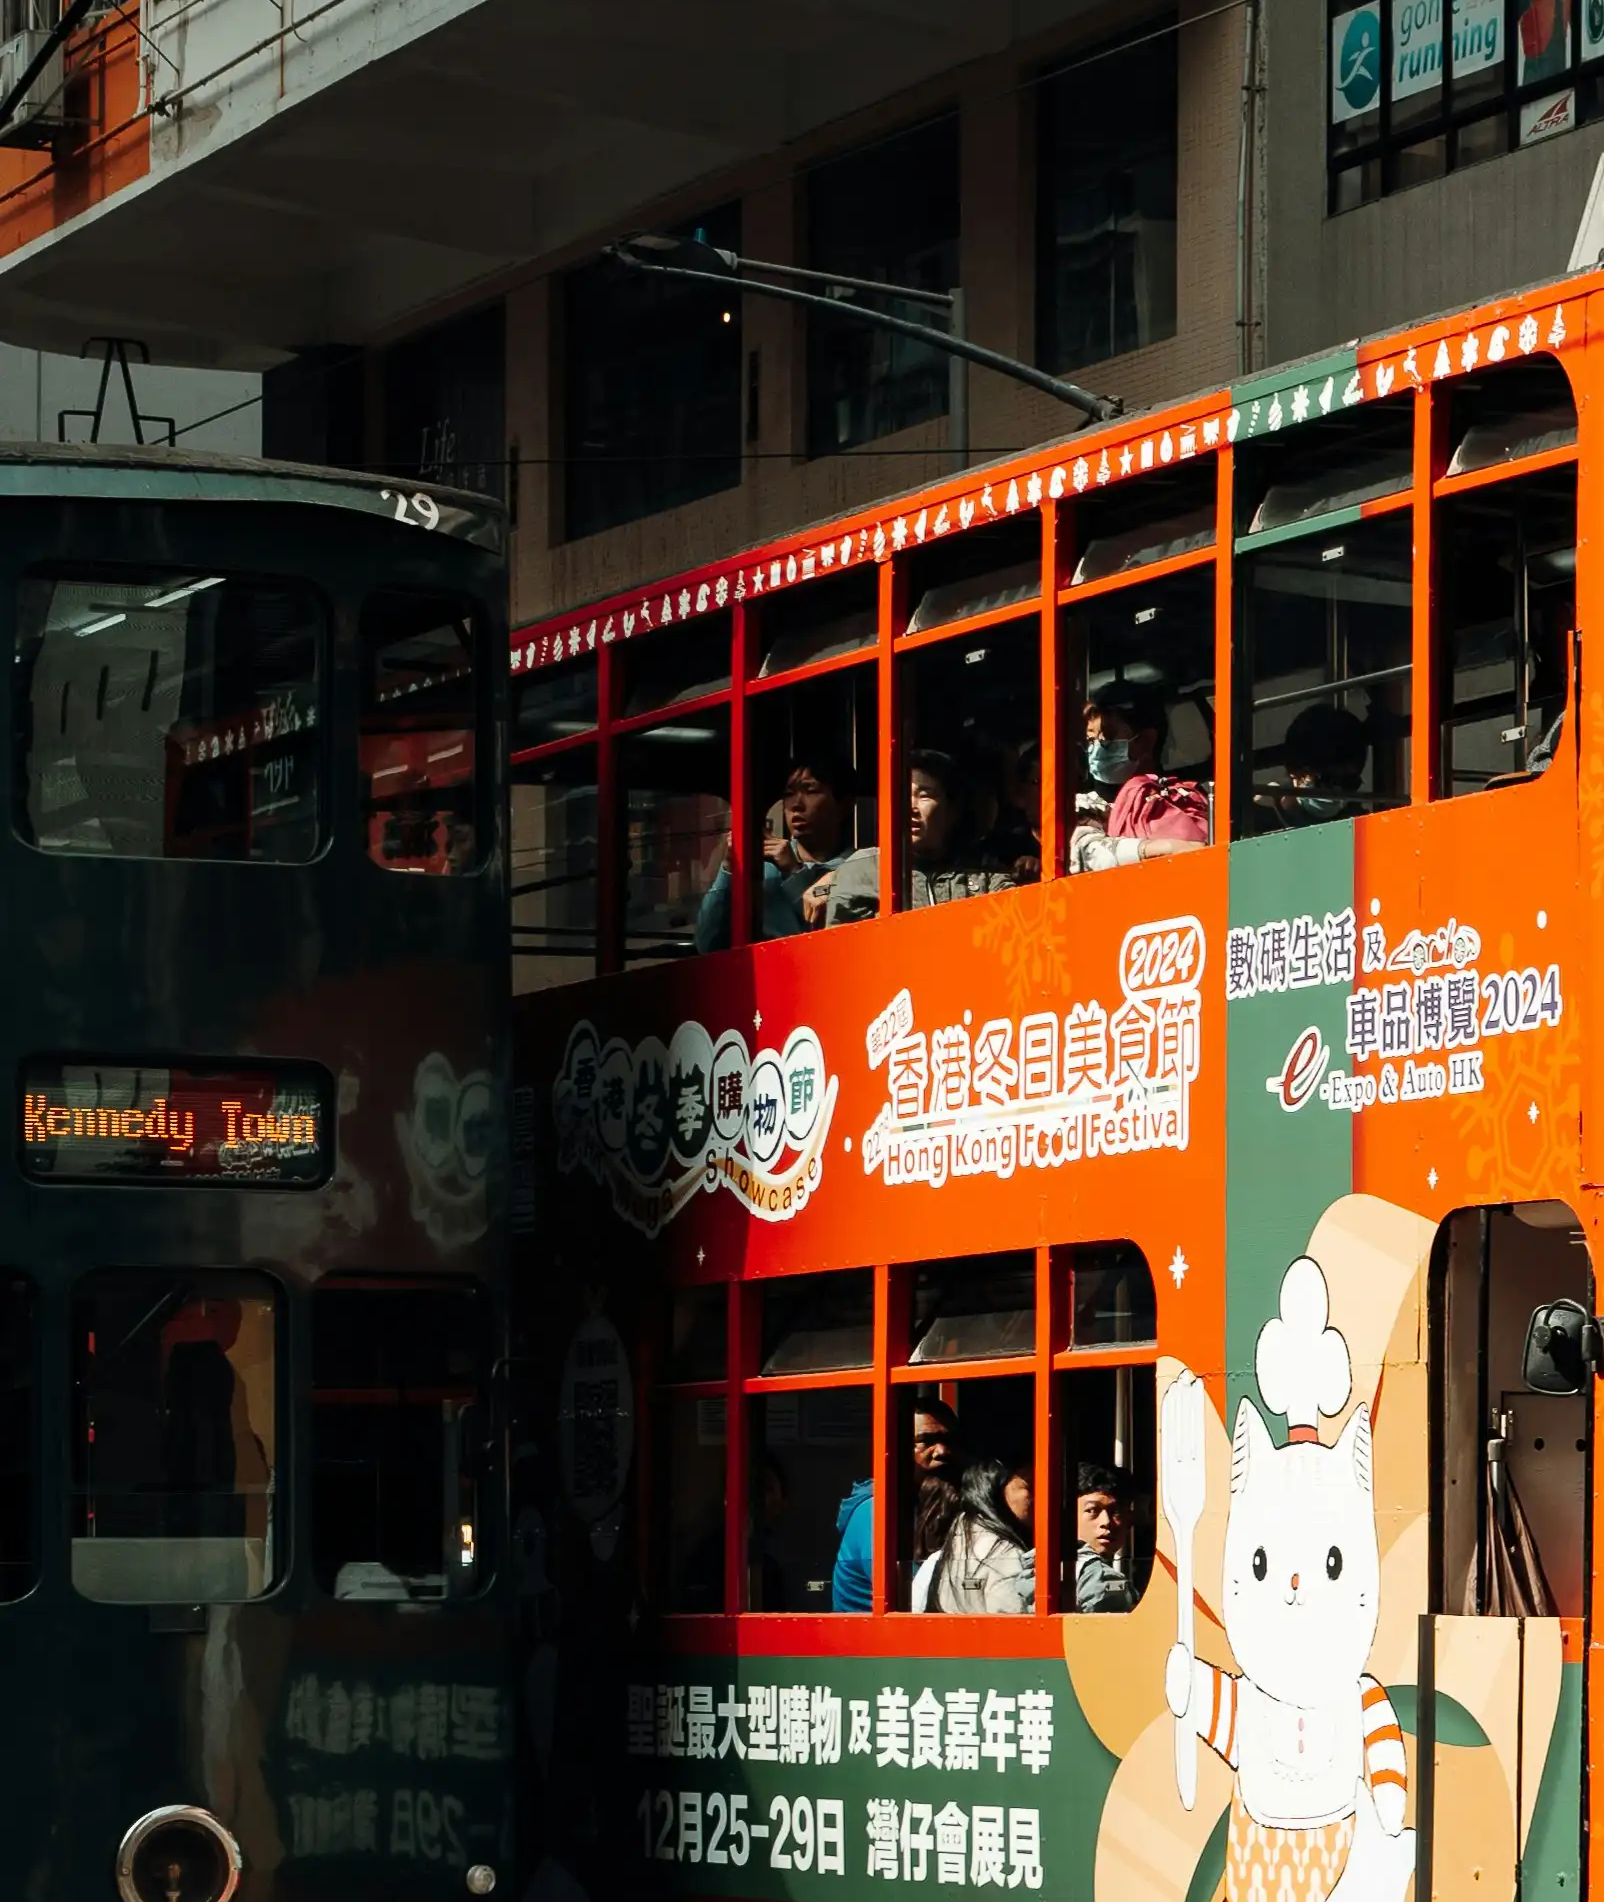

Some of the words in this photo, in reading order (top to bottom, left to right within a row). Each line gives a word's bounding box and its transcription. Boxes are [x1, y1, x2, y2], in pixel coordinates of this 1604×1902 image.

[1526, 113, 1570, 137] ALTRA
[380, 489, 441, 531] 29
[1128, 928, 1196, 992] 2024
[1350, 973, 1477, 1056] 車品博覽
[1485, 970, 1560, 1031] 2024
[892, 996, 1198, 1121] 香港冬日美食節
[1382, 1070, 1397, 1097] &
[1403, 1064, 1444, 1095] Auto
[1451, 1055, 1482, 1089] HK
[23, 1094, 196, 1152] Kennedy
[220, 1099, 316, 1150] Town
[888, 1142, 945, 1179] Hong
[956, 1132, 1012, 1167] Kong
[1024, 1116, 1078, 1158] Food
[705, 1148, 818, 1212] Showcase
[638, 1789, 845, 1876] 12月25-29日
[866, 1797, 1045, 1890] 灣仔會展見
